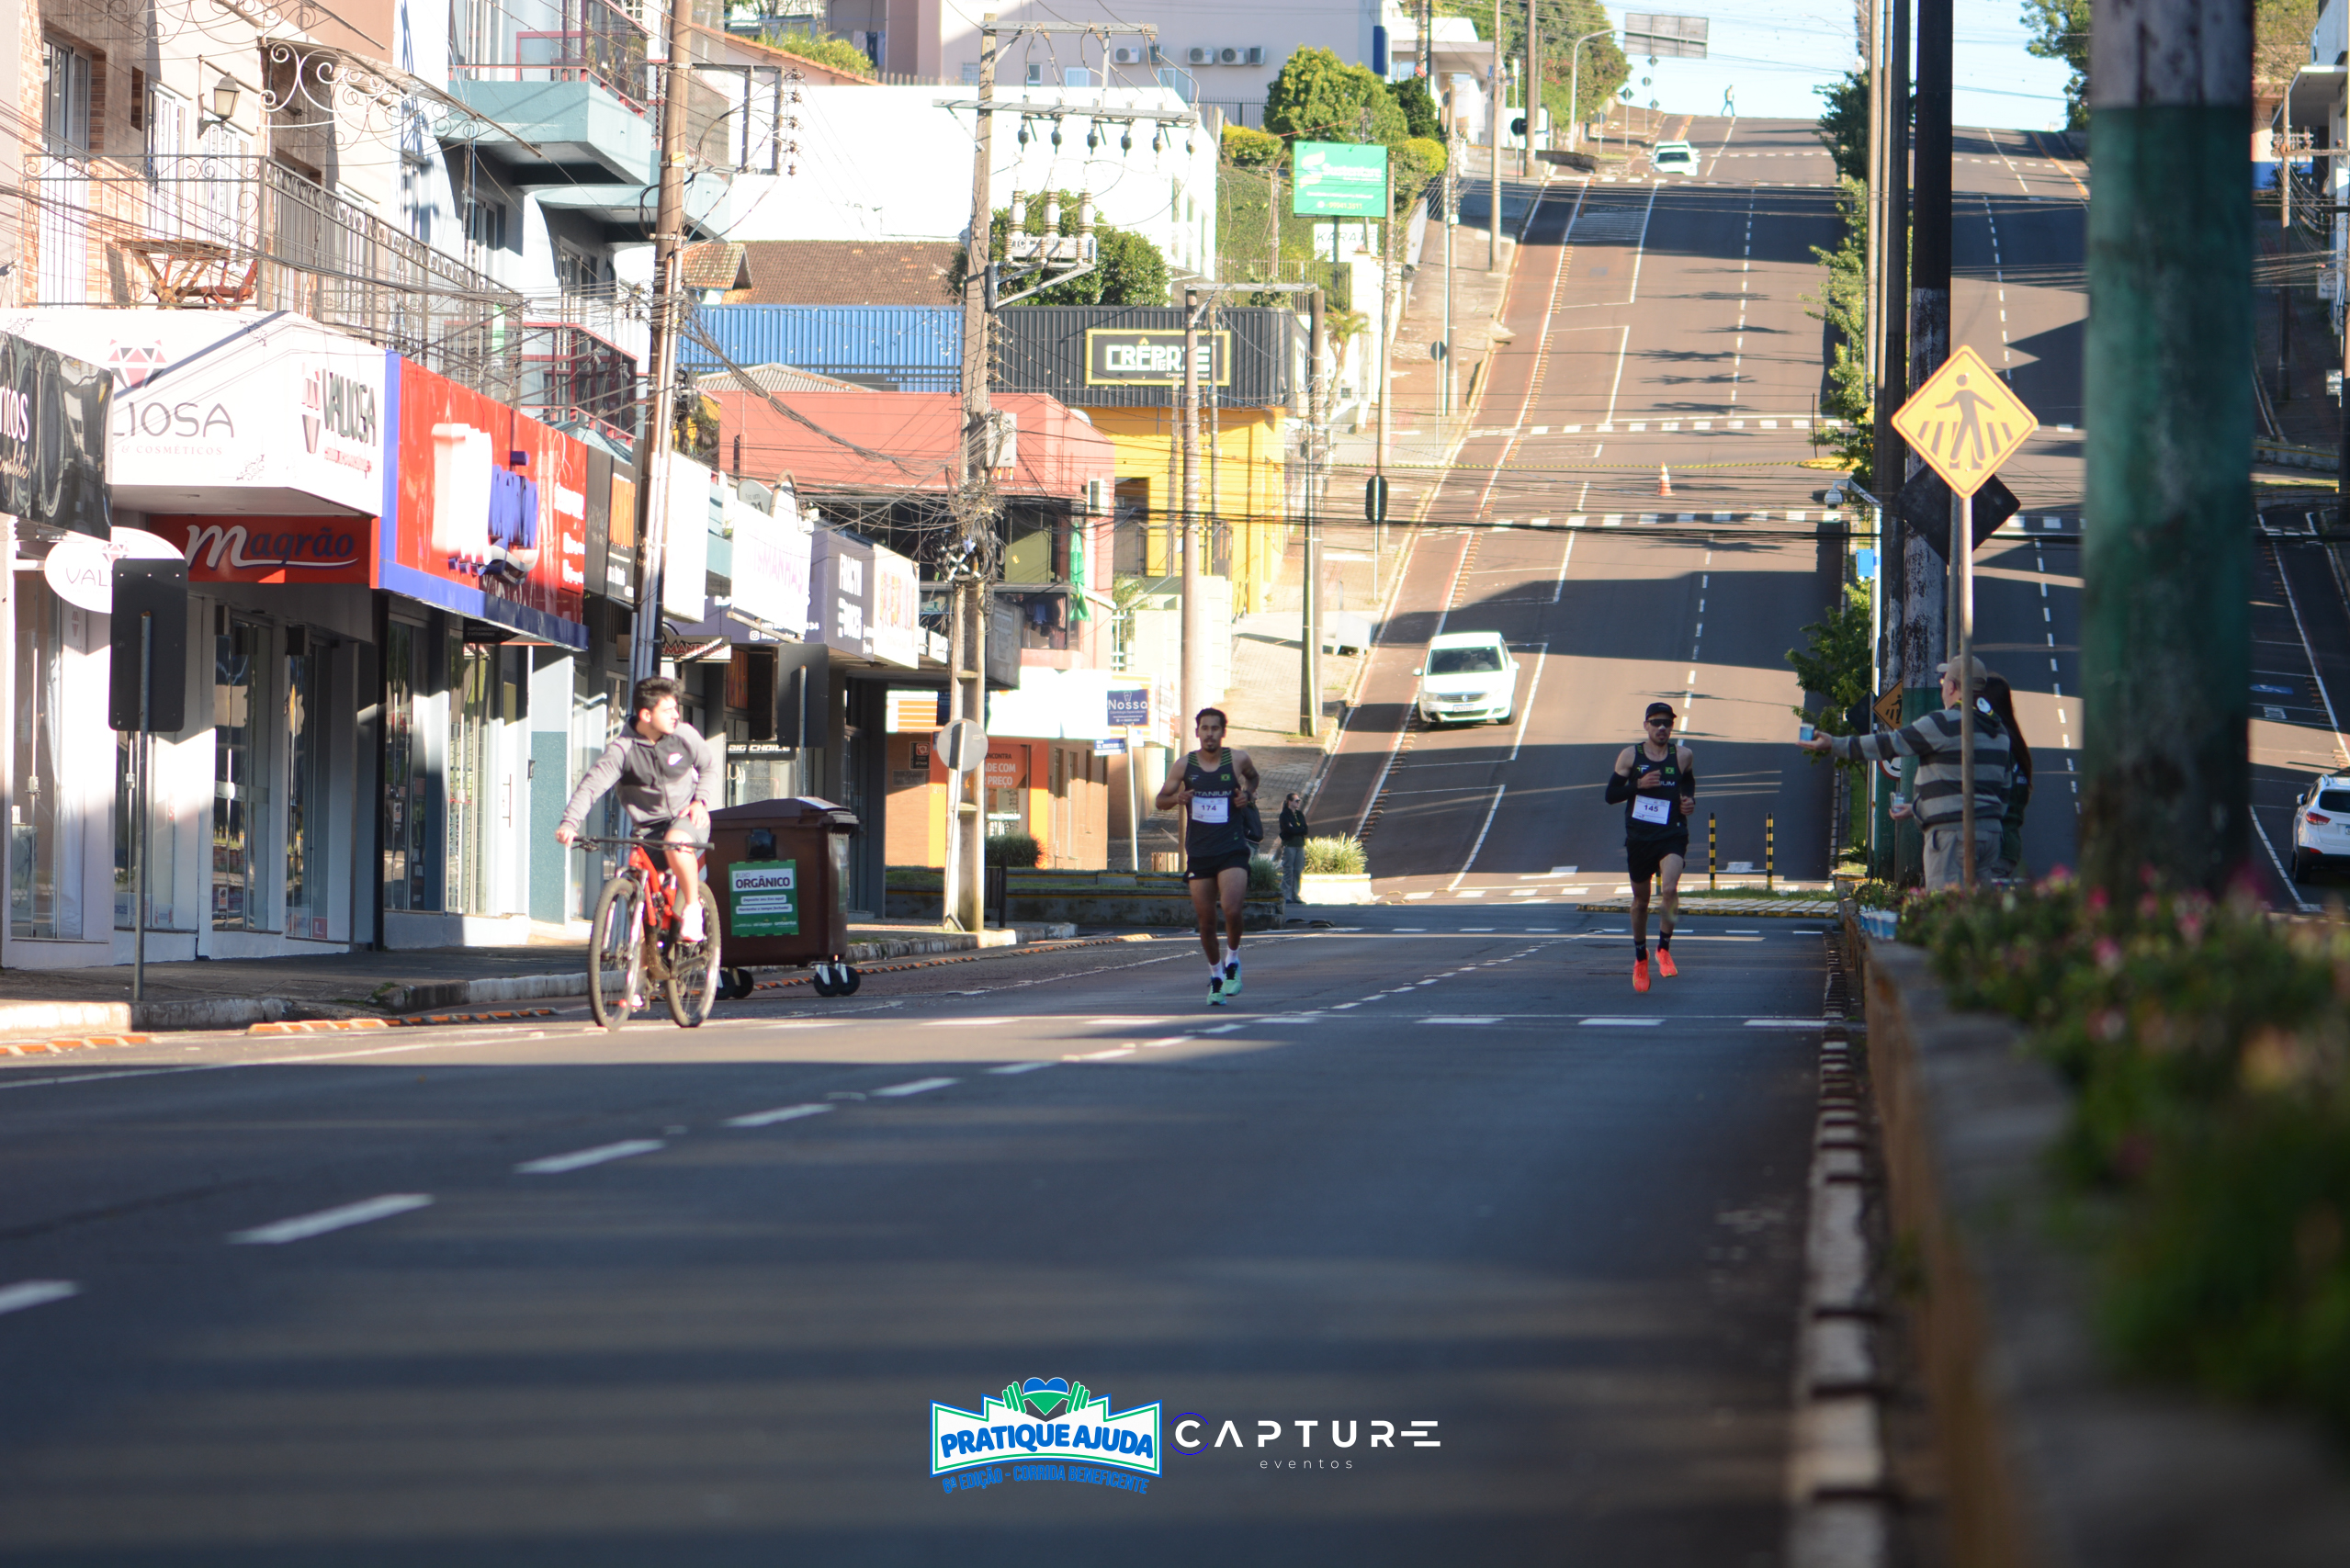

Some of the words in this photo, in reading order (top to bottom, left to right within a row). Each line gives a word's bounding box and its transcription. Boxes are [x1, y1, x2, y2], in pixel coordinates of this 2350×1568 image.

[322, 368, 376, 447] VALIOSA
[136, 445, 222, 456] COSMÉTICOS
[1108, 699, 1147, 710] Nossa
[999, 763, 1016, 773] COM
[988, 775, 1013, 788] PREÇO
[1644, 804, 1659, 813] 145
[736, 875, 791, 889] ORGÂNICO
